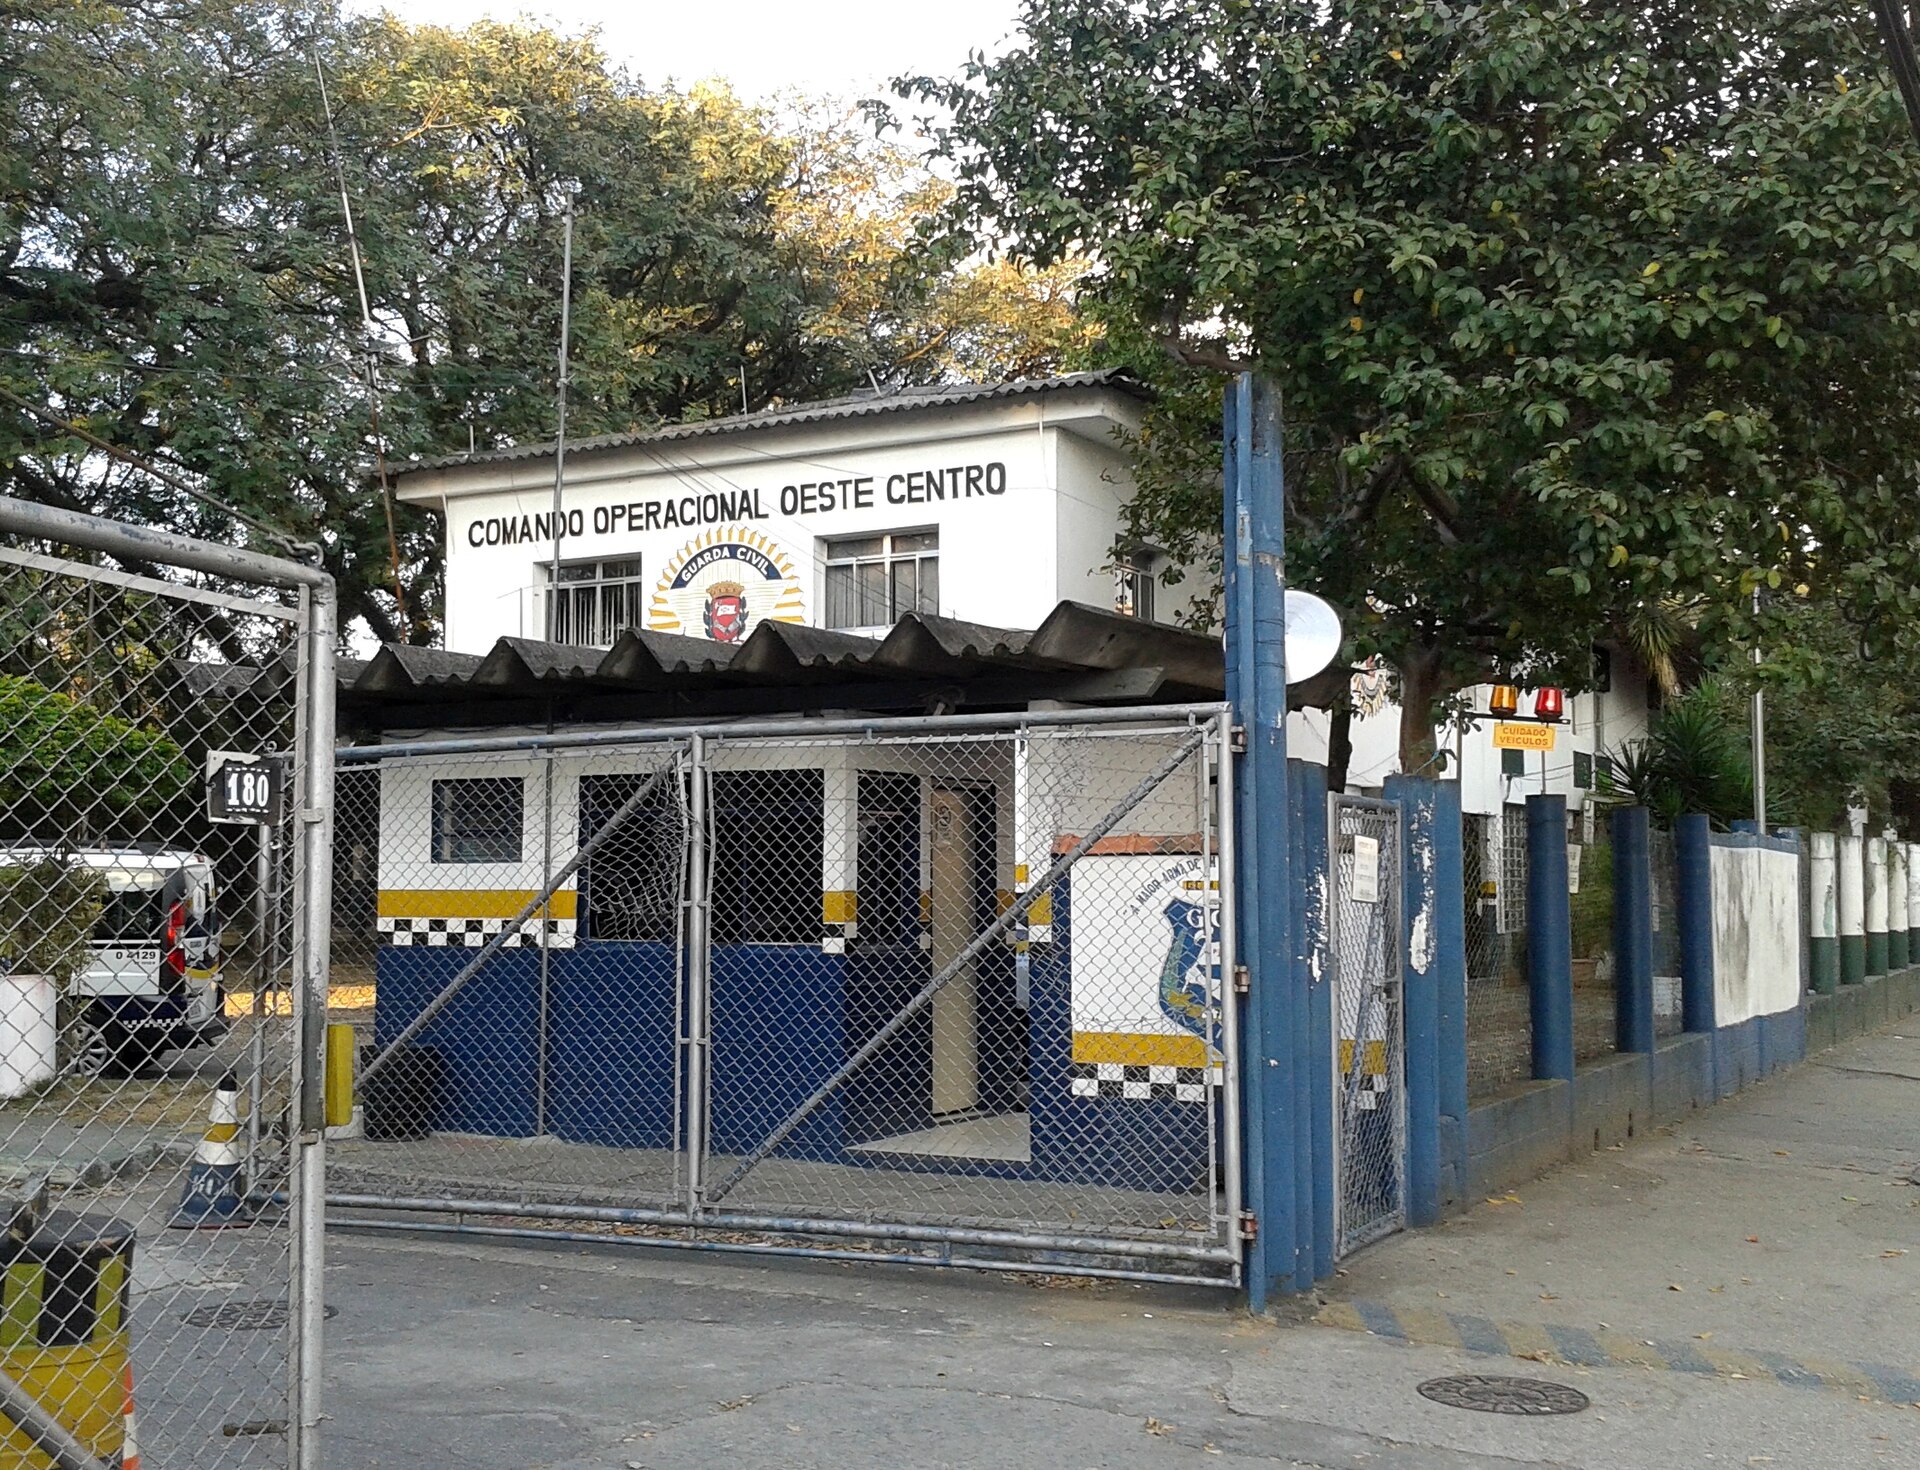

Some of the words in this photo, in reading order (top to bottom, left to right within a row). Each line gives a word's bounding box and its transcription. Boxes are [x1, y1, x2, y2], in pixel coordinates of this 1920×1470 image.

[468, 509, 584, 548] COMANDO
[594, 488, 769, 535] OPERACIONAL
[780, 476, 874, 516] OESTE
[886, 462, 1006, 505] CENTRO
[681, 546, 731, 582] GUARDA
[736, 547, 769, 576] CIVIL
[1499, 735, 1549, 746] VEICULOS
[1502, 727, 1547, 737] CUIDADO
[228, 772, 269, 807] 180
